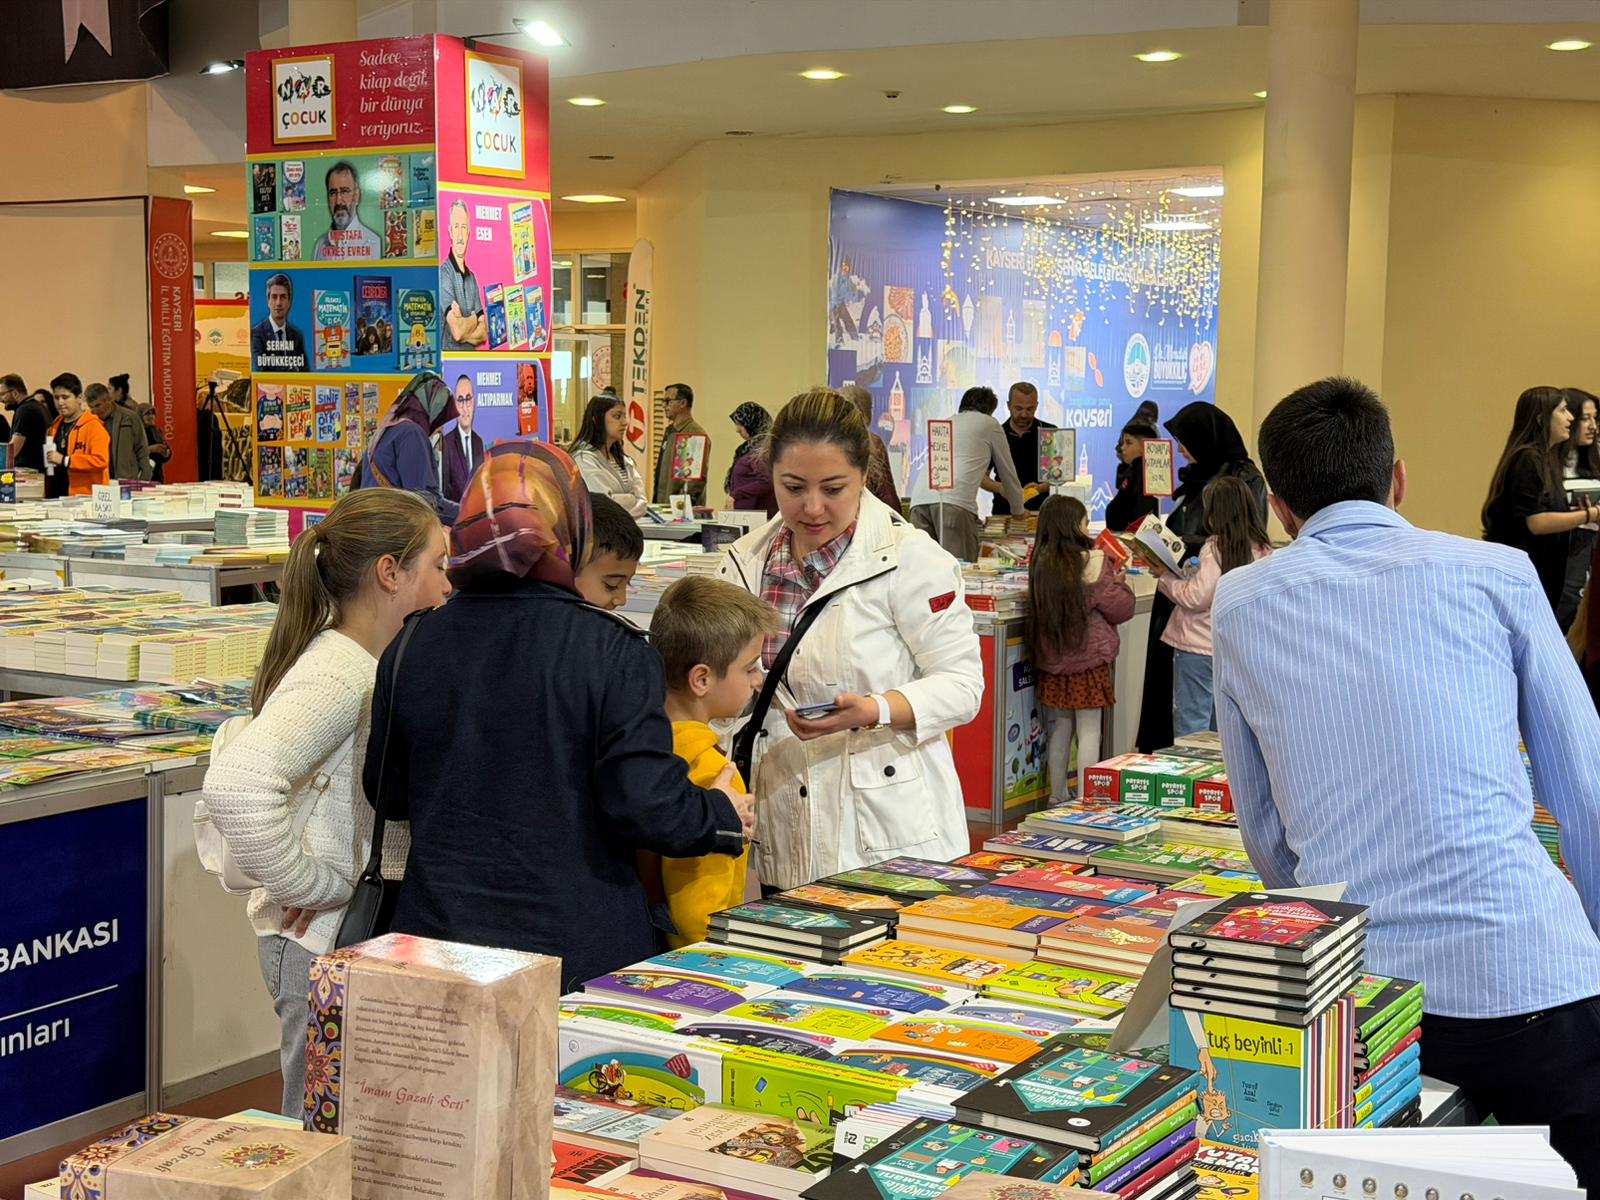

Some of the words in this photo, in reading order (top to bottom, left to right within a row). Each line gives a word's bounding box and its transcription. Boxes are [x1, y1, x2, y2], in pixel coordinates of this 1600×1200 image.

[360, 49, 401, 67] Sadece
[360, 72, 391, 93] kitap
[360, 97, 379, 113] bir
[381, 95, 424, 116] dünya
[282, 110, 327, 130] ÇOCUK
[361, 120, 424, 141] veriyoruz.
[475, 130, 517, 155] ÇOCUK
[173, 286, 183, 332] KAYSERİ
[266, 340, 294, 351] SERHAN
[631, 289, 646, 397] TEKDEN
[257, 353, 305, 367] BÜYÜKKEÇECİ
[477, 372, 502, 386] MEHMET
[477, 392, 513, 407] ALTIPARMAK
[0, 918, 119, 973] BANKASI
[1207, 1030, 1231, 1052] tuş
[1234, 1032, 1283, 1056] beyinli
[396, 1088, 434, 1106] Gazali
